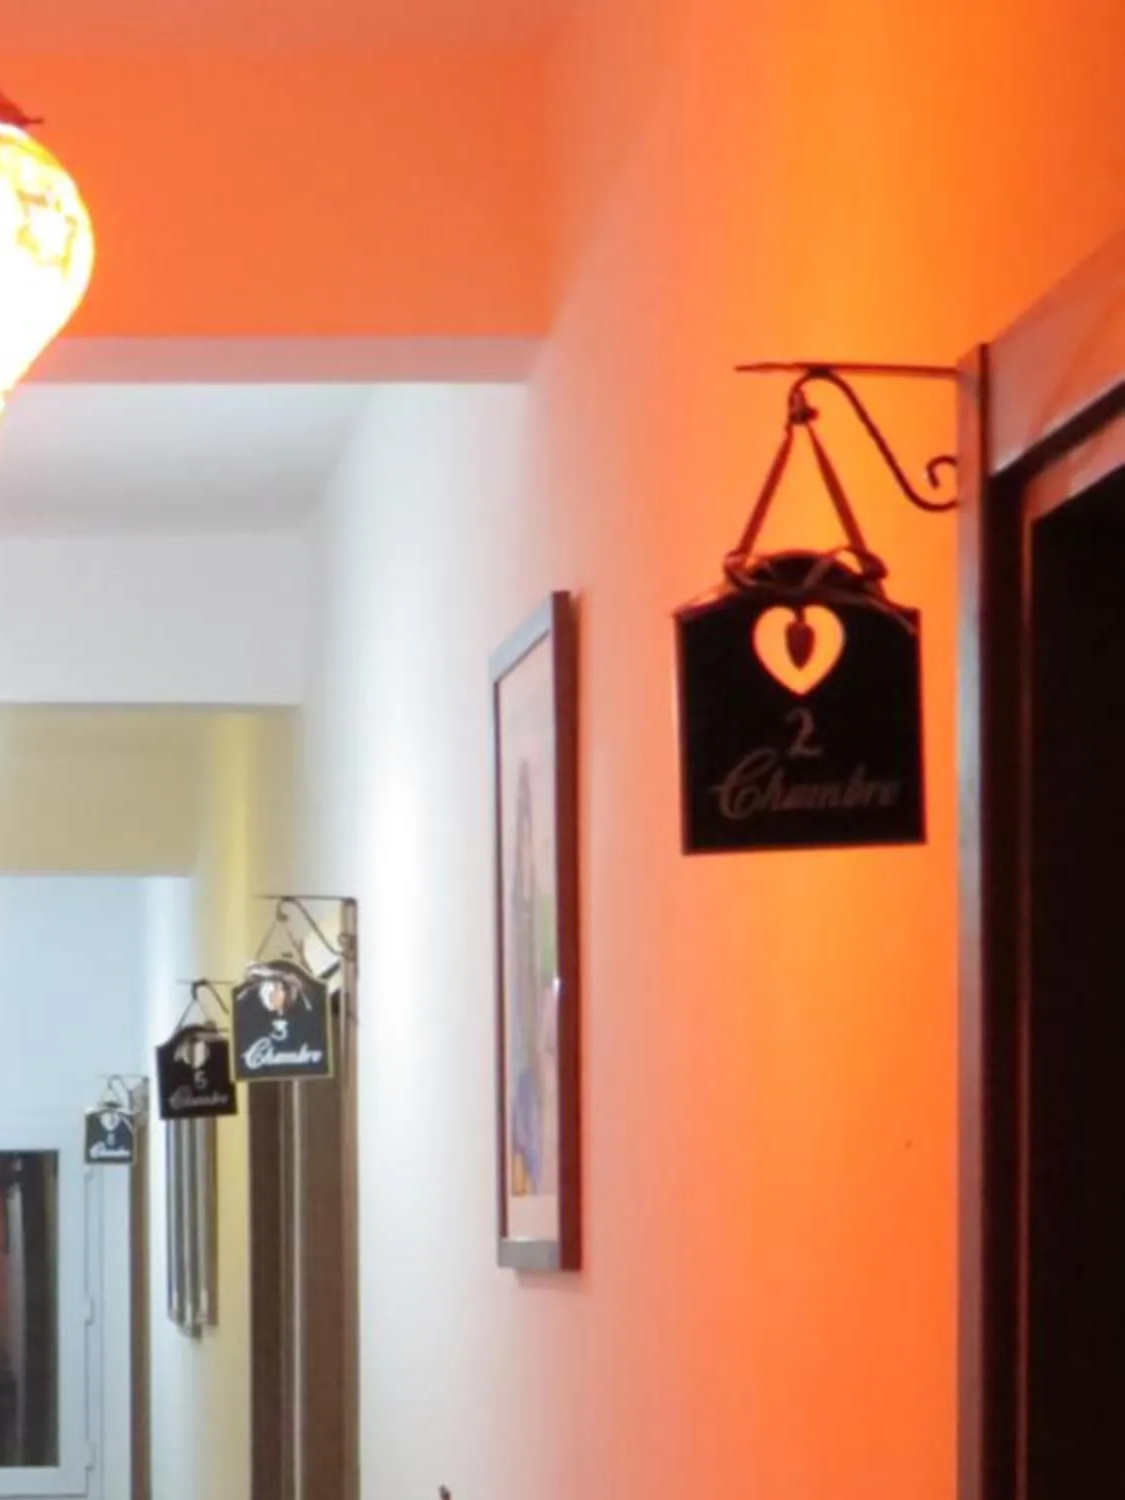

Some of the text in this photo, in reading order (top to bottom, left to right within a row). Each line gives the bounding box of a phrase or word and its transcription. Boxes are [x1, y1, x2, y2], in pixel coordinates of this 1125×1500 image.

[784, 706, 824, 758] 2
[269, 1020, 288, 1041] 3
[194, 1070, 208, 1089] 5
